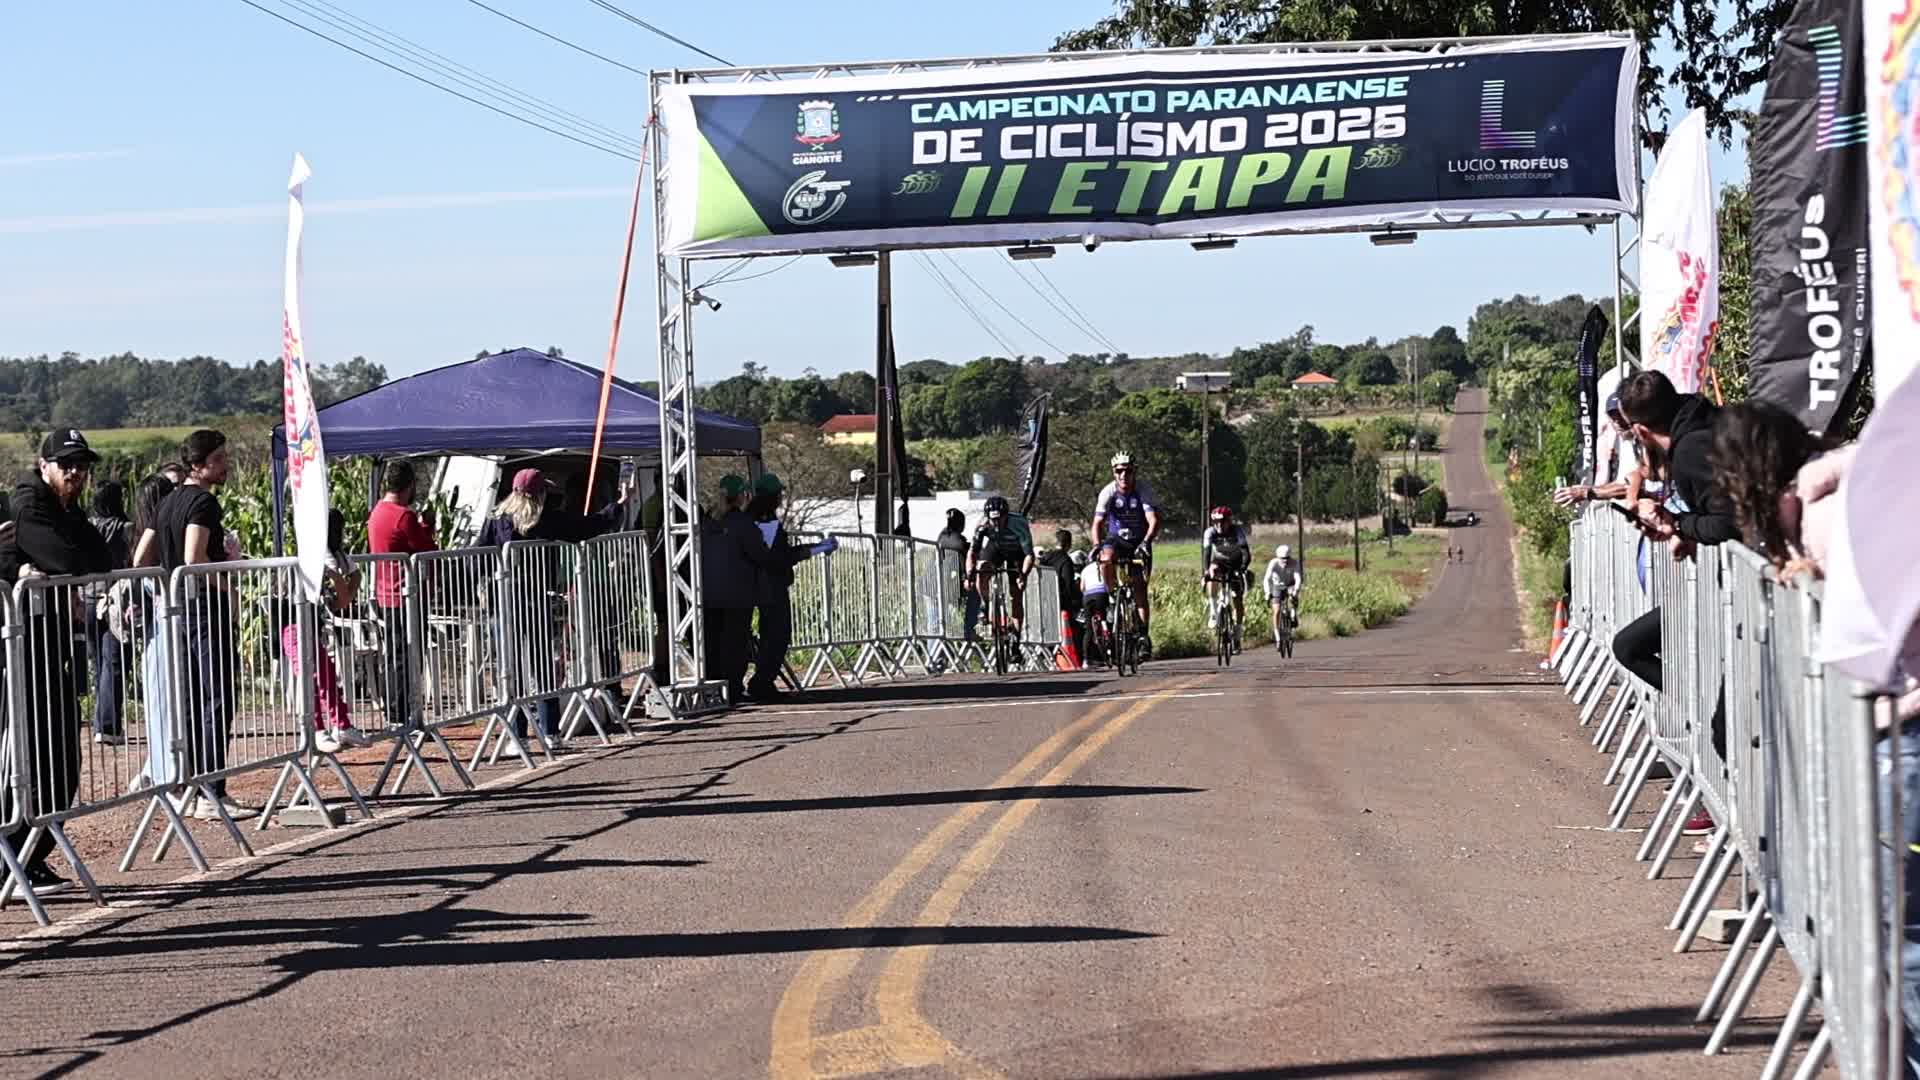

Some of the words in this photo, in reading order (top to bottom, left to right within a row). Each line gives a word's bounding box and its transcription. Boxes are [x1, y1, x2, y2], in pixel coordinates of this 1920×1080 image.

[911, 90, 1156, 123] CAMPEONATO
[1167, 76, 1410, 113] PARANAENSE
[792, 154, 843, 165] CIANORTE
[912, 128, 983, 165] DE
[1000, 112, 1248, 160] CICLÍSMO
[950, 164, 1028, 218] II
[1048, 146, 1353, 216] ETAPA
[1448, 158, 1496, 173] LUCIO
[1500, 155, 1569, 170] TROFÉUS
[1793, 193, 1842, 411] TROFÉUS
